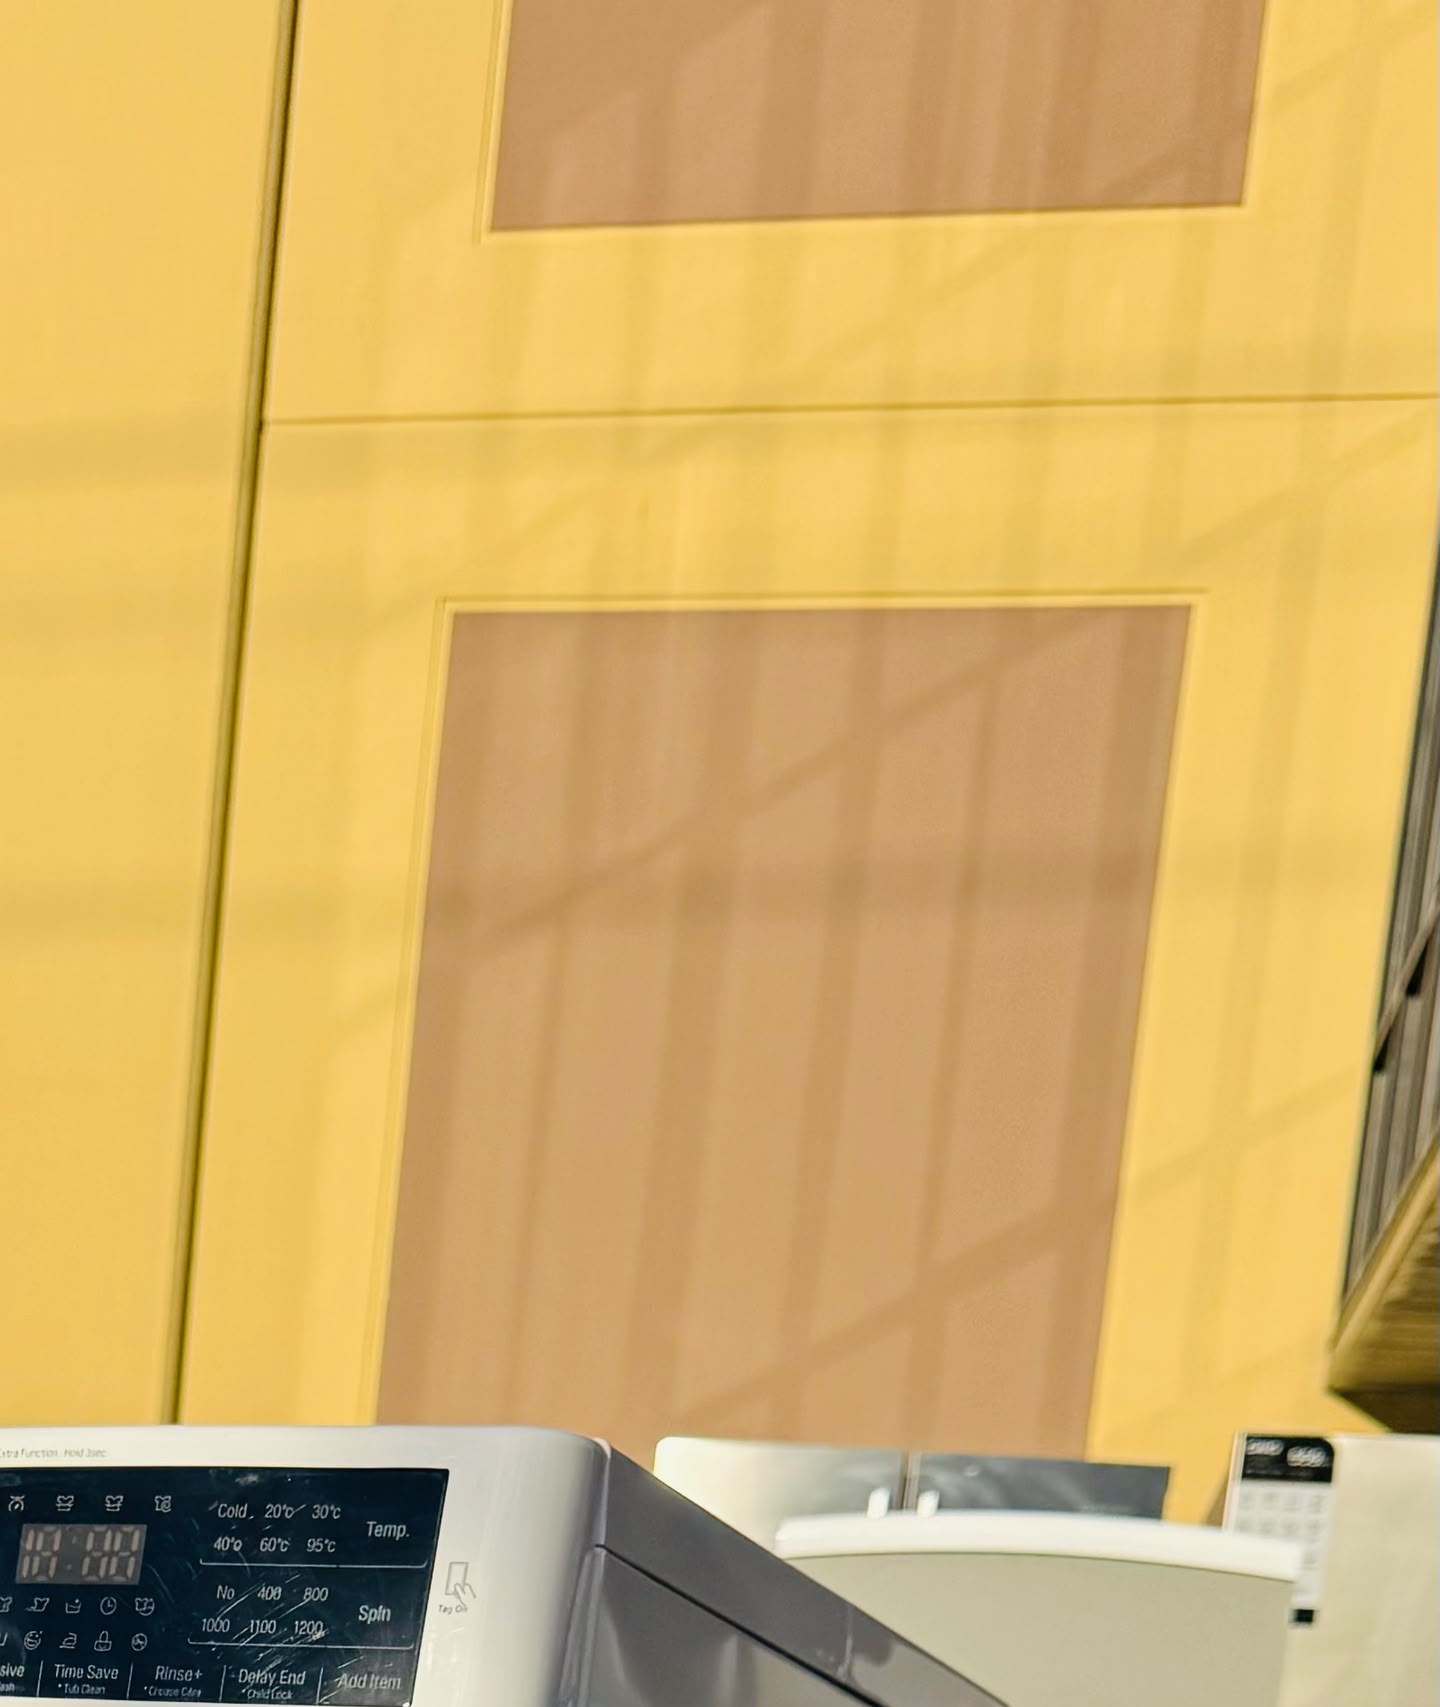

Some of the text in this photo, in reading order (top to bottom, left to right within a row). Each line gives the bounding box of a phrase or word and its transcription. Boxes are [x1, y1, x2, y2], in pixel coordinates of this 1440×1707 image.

[217, 1503, 248, 1519] Cold
[366, 1521, 410, 1540] Temp.
[216, 1585, 235, 1600] No
[303, 1587, 329, 1602] 800
[358, 1605, 391, 1625] Spin
[201, 1618, 231, 1633] 1000
[294, 1621, 324, 1635] 1200
[54, 1663, 119, 1680] Time Save
[155, 1665, 203, 1681] Rinse+
[238, 1668, 307, 1685] Delay End
[337, 1672, 402, 1690] Add Item
